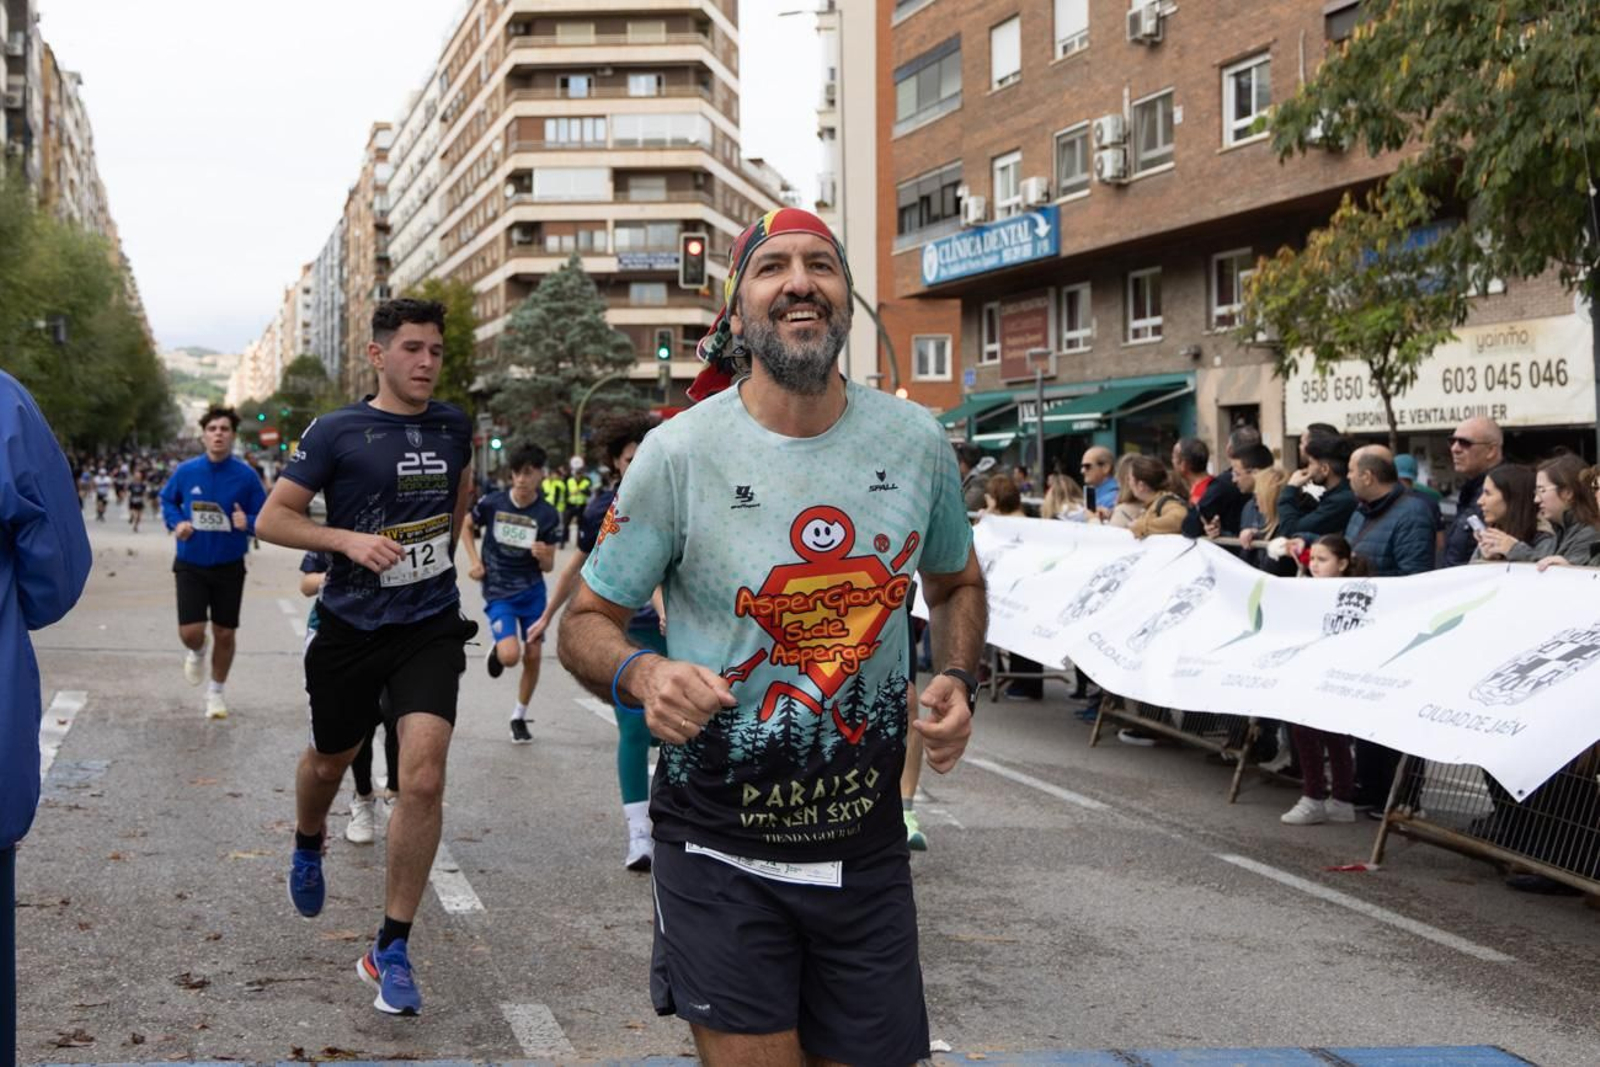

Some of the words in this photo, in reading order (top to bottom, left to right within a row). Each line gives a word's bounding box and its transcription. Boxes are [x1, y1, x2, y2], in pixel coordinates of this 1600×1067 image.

[984, 220, 1033, 253] DENTAL
[1302, 379, 1329, 403] 958
[1334, 375, 1363, 400] 650
[1442, 365, 1478, 394] 603
[1484, 361, 1522, 391] 045
[1529, 358, 1569, 388] 046
[397, 452, 448, 475] 25
[869, 483, 899, 492] SPALL
[199, 513, 224, 525] 553
[502, 525, 527, 541] 956
[769, 640, 882, 675] Asperger
[1418, 703, 1470, 730] CIUDAD
[1465, 713, 1490, 733] DE
[741, 767, 880, 808] PARAISO
